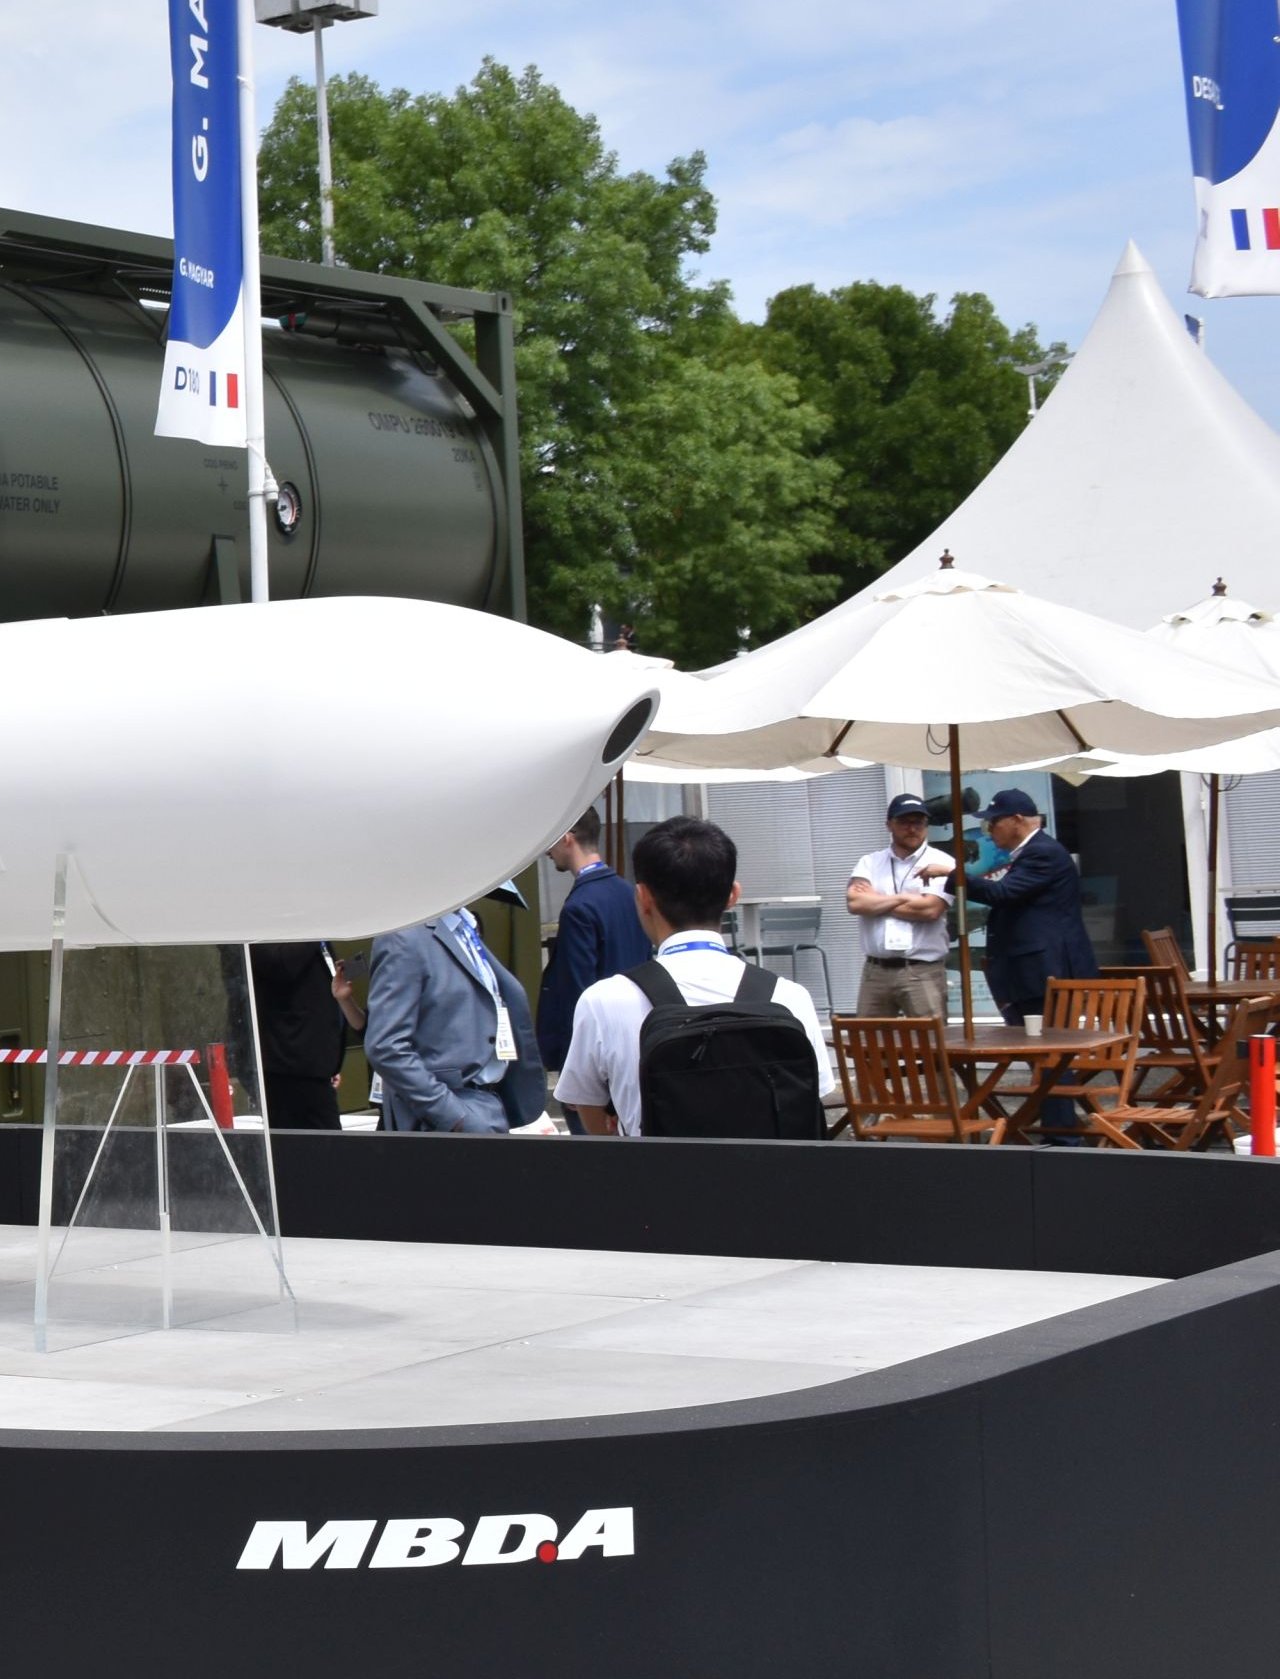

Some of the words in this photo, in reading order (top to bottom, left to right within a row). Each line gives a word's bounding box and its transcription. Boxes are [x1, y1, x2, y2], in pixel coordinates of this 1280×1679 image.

[192, 117, 208, 182] G.
[32, 497, 61, 514] ONLY
[235, 1506, 635, 1570] MBDA
